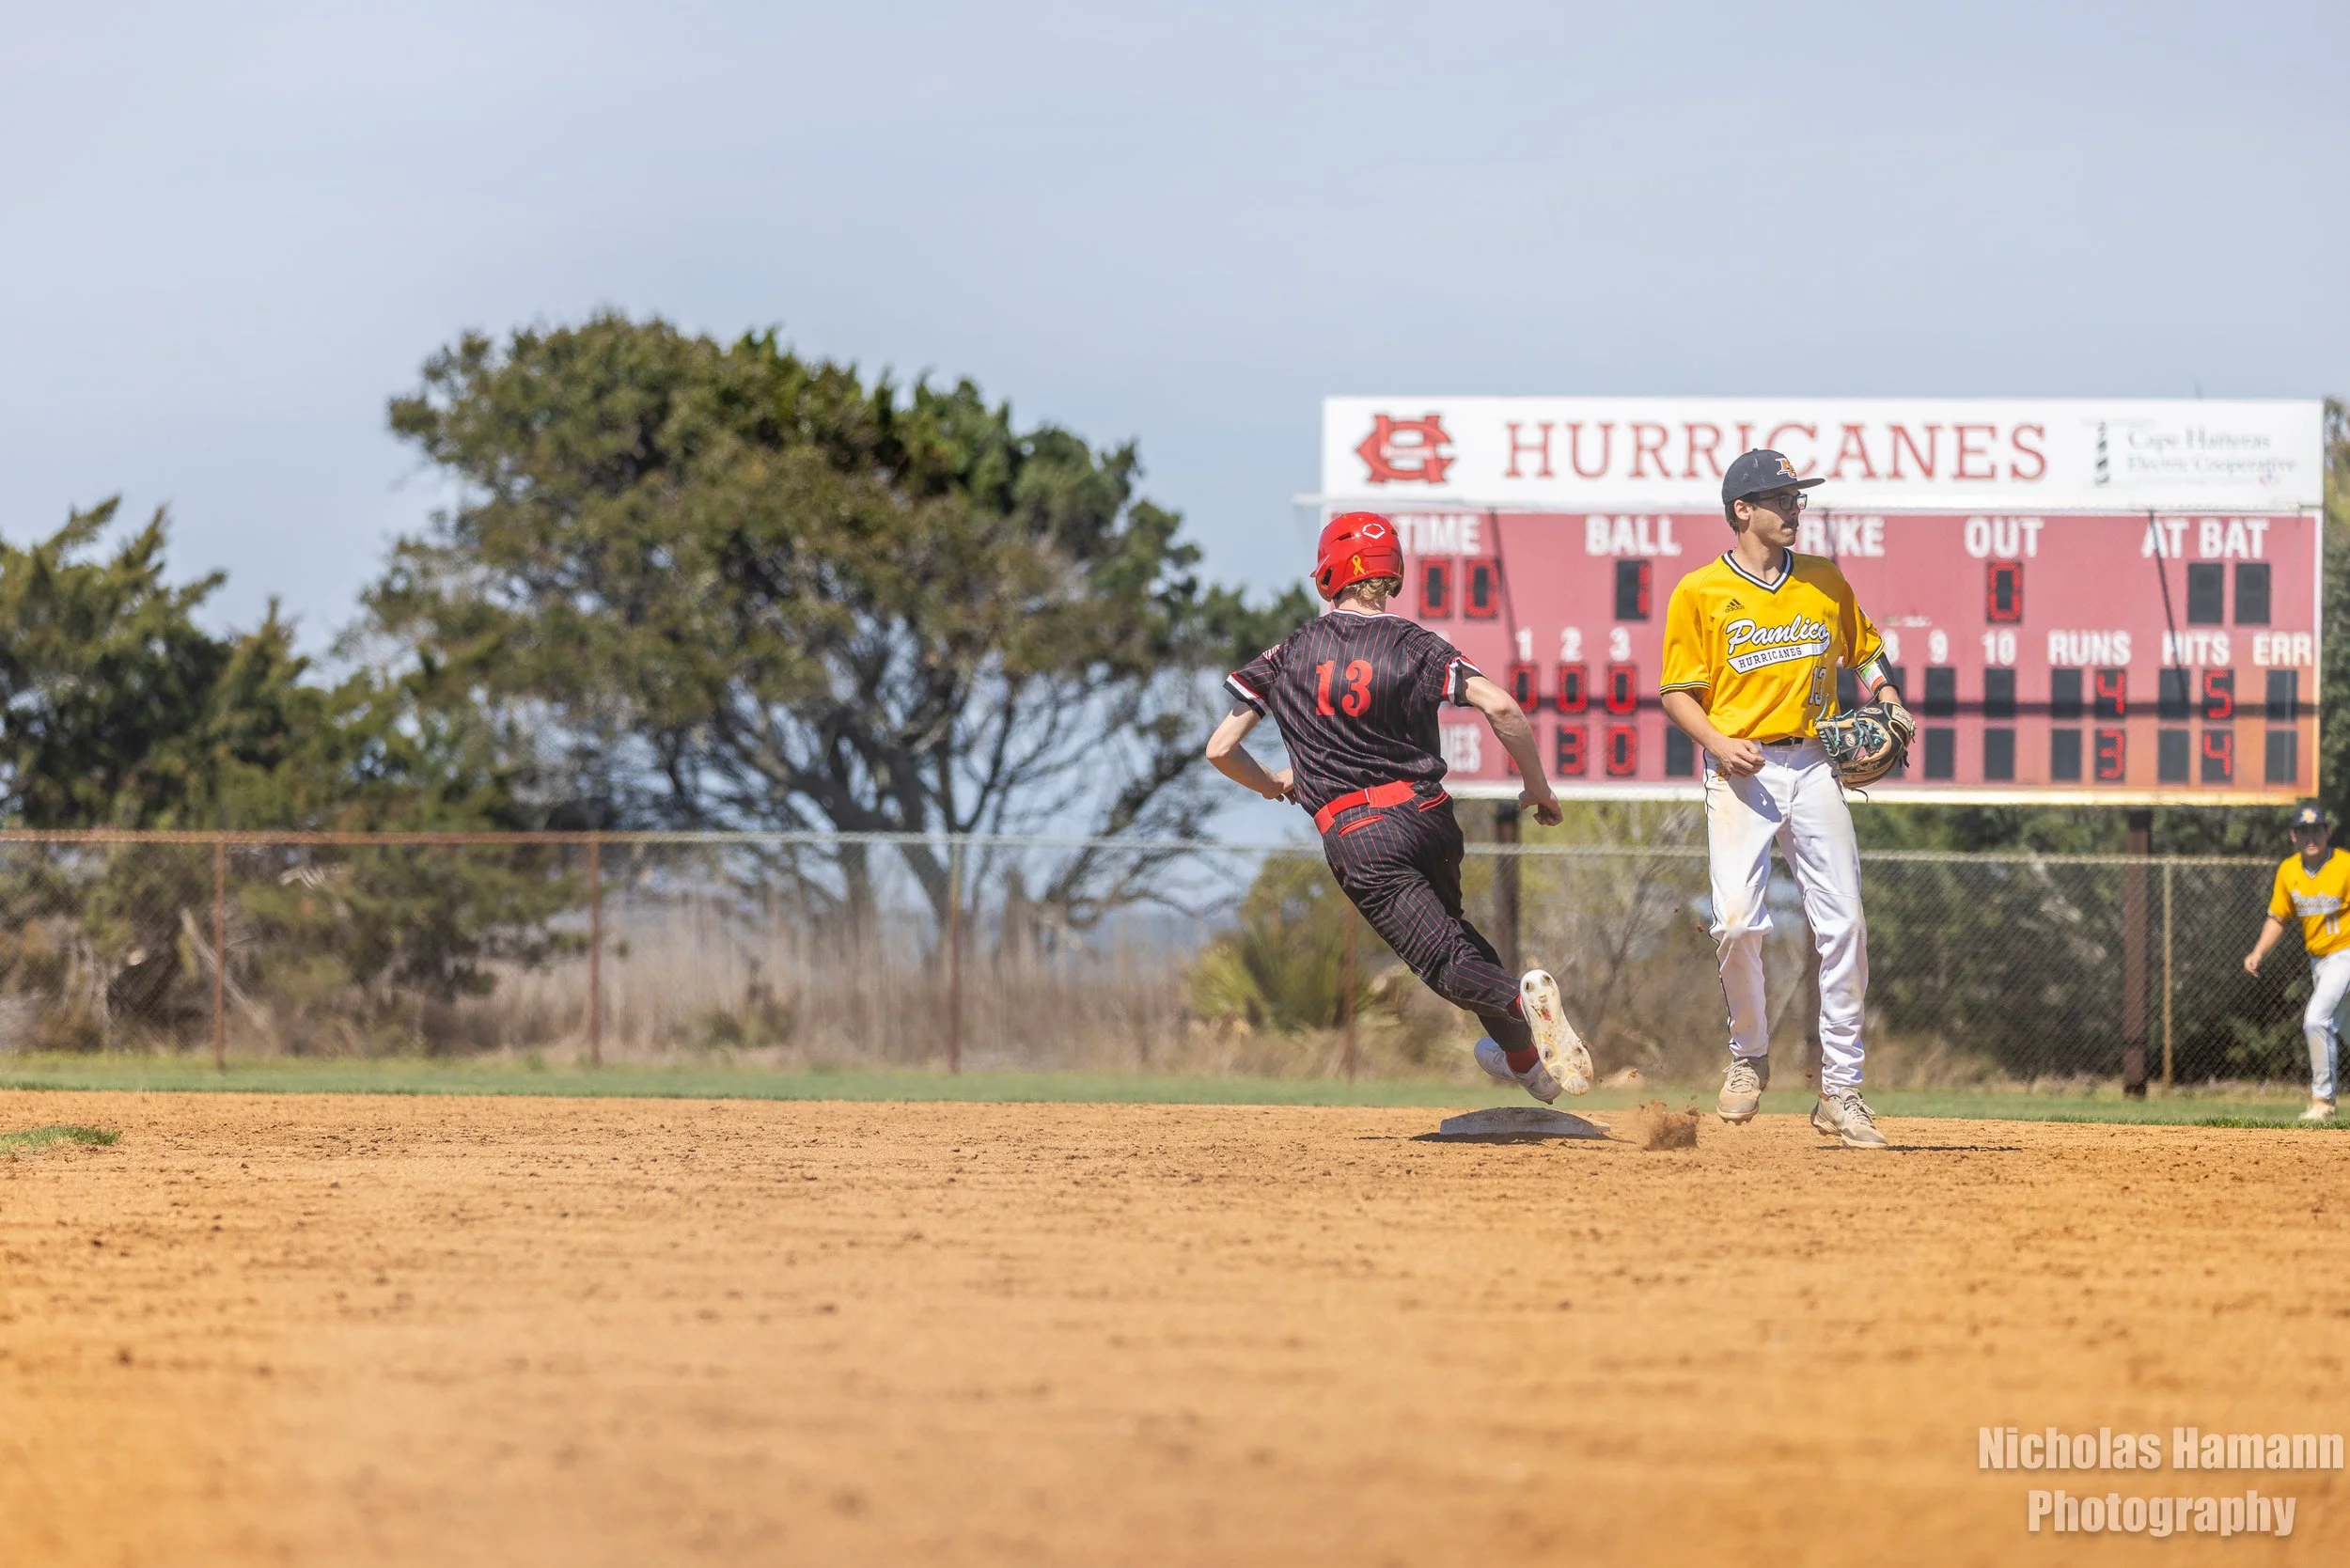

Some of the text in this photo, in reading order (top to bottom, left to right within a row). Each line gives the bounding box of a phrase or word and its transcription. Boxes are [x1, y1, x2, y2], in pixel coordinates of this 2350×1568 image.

[1504, 420, 2047, 480] HURRICANES
[1393, 515, 1482, 557] TIME
[1584, 514, 1683, 557] BALL
[1797, 514, 1886, 557] RIKE
[1964, 515, 2045, 559] OUT
[2140, 517, 2271, 559] AT BAT
[1514, 626, 1534, 663] 1
[1559, 625, 1583, 662] 2
[1608, 625, 1632, 662] 3
[1981, 629, 2017, 666] 10
[2046, 629, 2133, 666] RUNS
[2163, 630, 2232, 666] HITS
[2251, 630, 2313, 666] ERR
[1726, 613, 1830, 655] Pamlico
[1738, 647, 1803, 669] HURRICANES
[1316, 659, 1373, 717] 13
[2096, 672, 2125, 715] 4
[2203, 668, 2233, 719] 5
[2098, 729, 2125, 779] 3
[2202, 732, 2232, 777] 4
